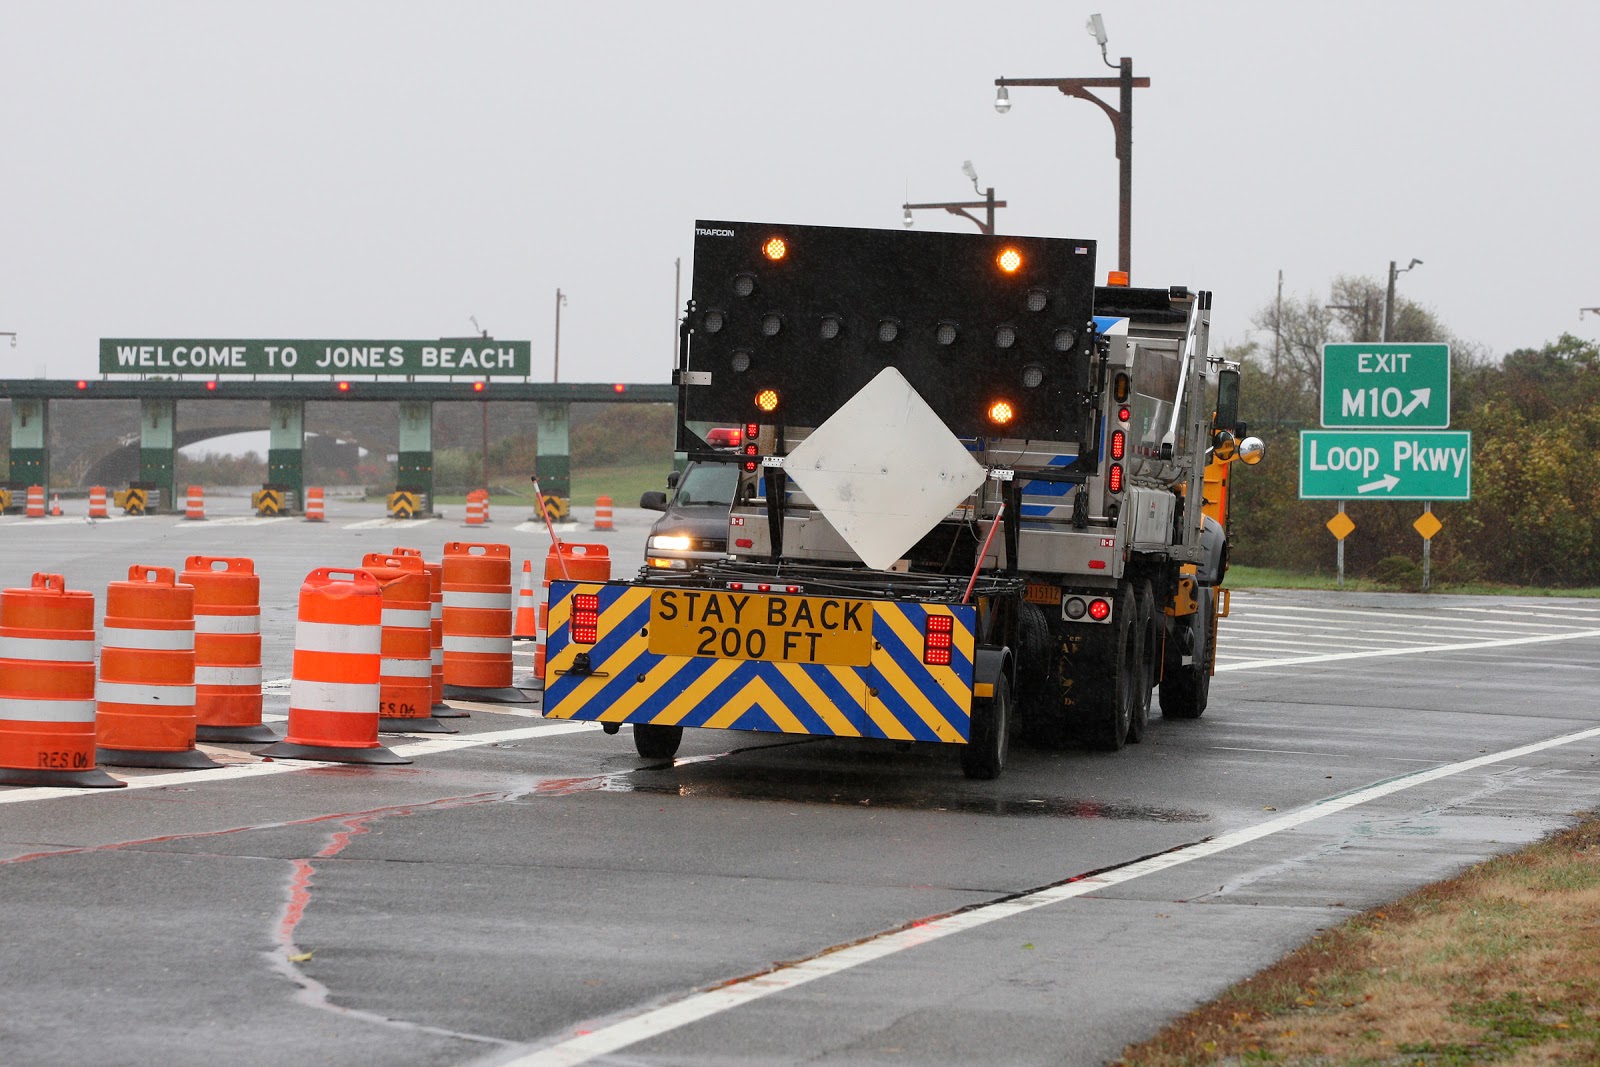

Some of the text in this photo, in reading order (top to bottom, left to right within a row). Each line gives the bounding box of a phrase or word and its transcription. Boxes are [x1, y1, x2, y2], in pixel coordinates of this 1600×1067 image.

[695, 228, 735, 237] TRAFCON
[117, 345, 515, 370] WELCOME TO JONES BEACH
[1358, 353, 1411, 373] EXIT
[1342, 387, 1402, 418] M10
[1310, 440, 1466, 478] Loop Pkwy
[659, 590, 863, 632] STAY BACK
[697, 626, 823, 662] 200 FT
[399, 703, 416, 718] 06
[37, 752, 88, 768] RES 06
